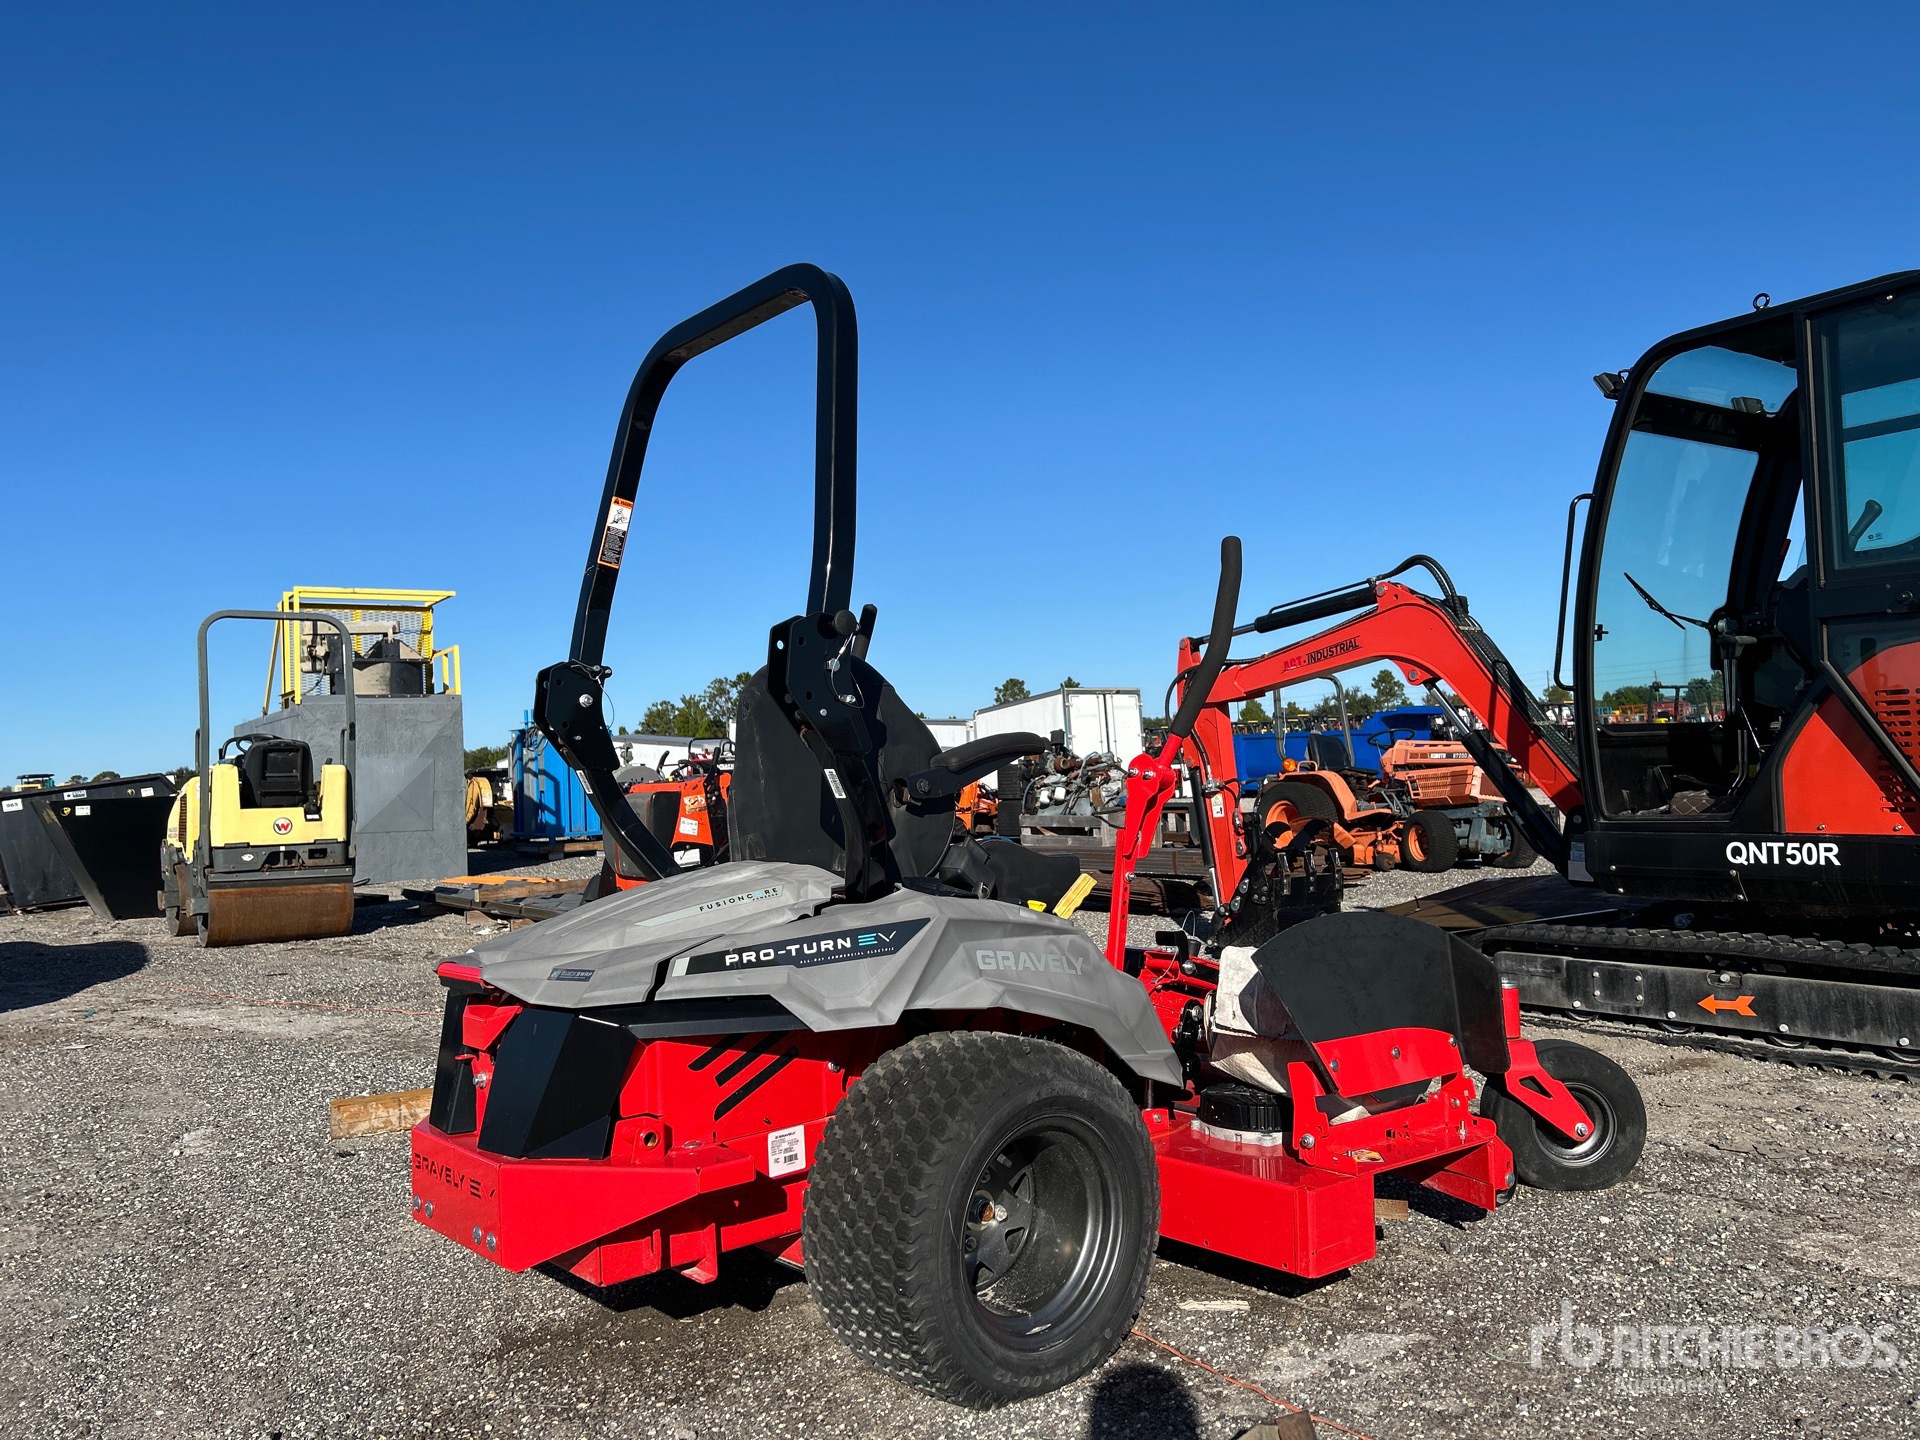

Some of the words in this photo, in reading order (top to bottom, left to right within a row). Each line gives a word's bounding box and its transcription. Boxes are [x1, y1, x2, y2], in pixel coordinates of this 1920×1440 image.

[1306, 638, 1360, 664] INDUSTRIAL
[1726, 842, 1841, 866] QNT50R
[699, 887, 778, 912] FUSIONCORE
[725, 937, 852, 966] PRO-TURN
[857, 930, 897, 946] EV
[976, 949, 1083, 975] GRAVELY
[414, 1152, 466, 1190] GRAVELY
